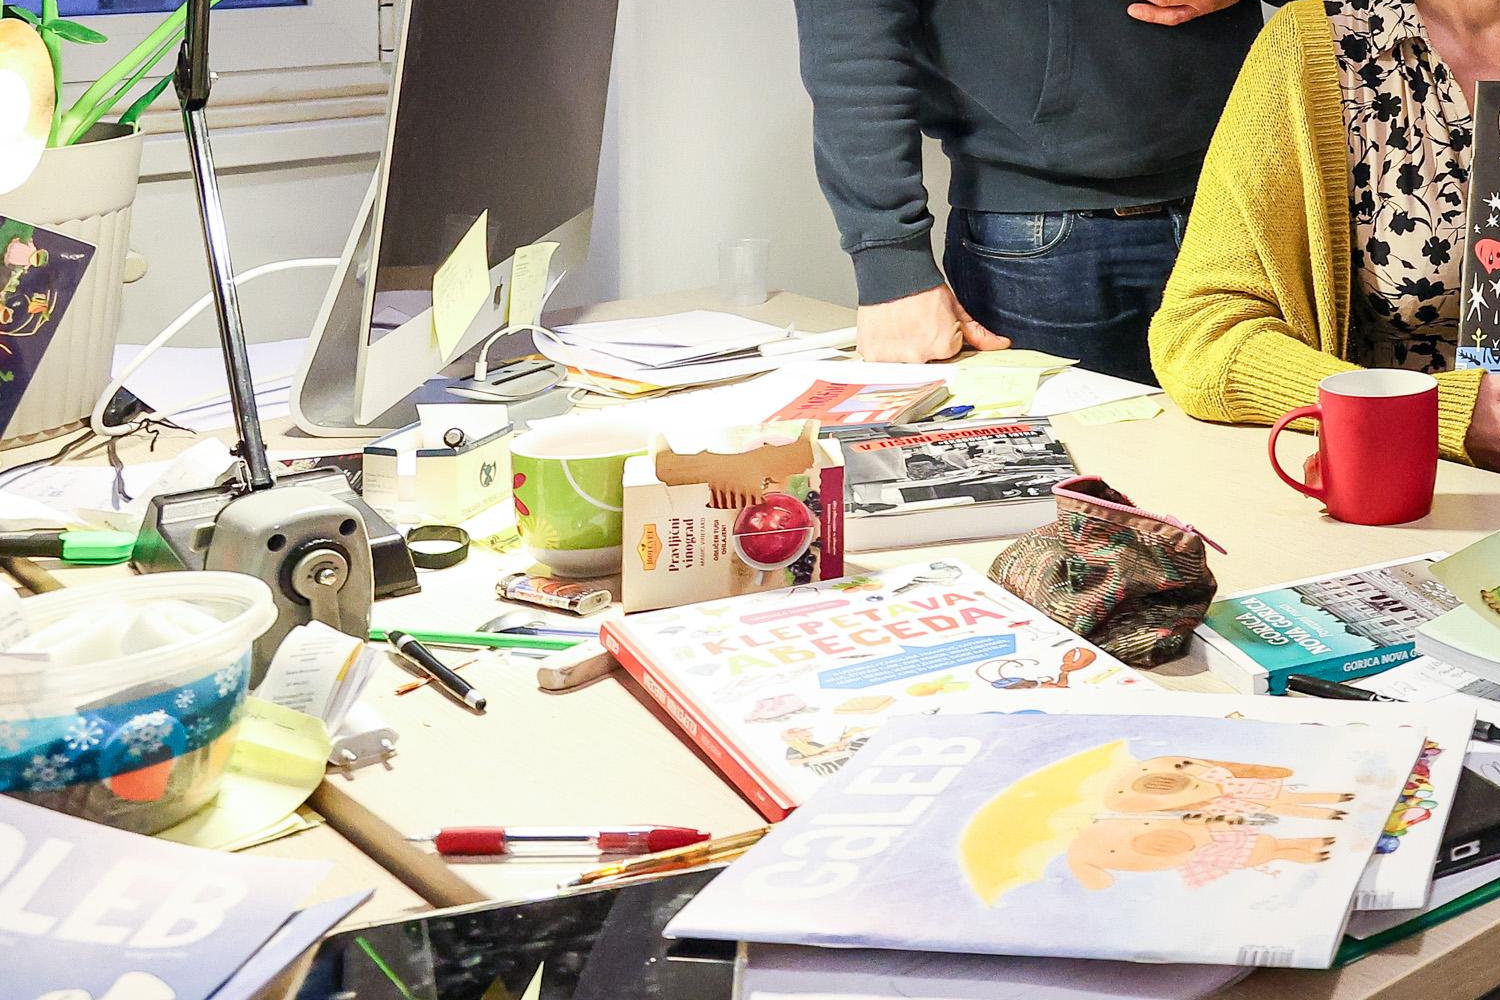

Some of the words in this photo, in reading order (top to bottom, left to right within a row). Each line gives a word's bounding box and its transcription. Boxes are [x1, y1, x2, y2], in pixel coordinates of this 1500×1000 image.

[938, 425, 1023, 441] SPOMINA
[682, 518, 695, 569] vinograd
[702, 592, 977, 655] KLEPETAVA
[1235, 612, 1289, 647] GORICA
[1239, 597, 1294, 629] GORICA
[728, 606, 1006, 676] ABECEDA
[1284, 627, 1335, 656] NOVA
[1343, 655, 1380, 672] GORICA
[1380, 651, 1409, 665] NOVA
